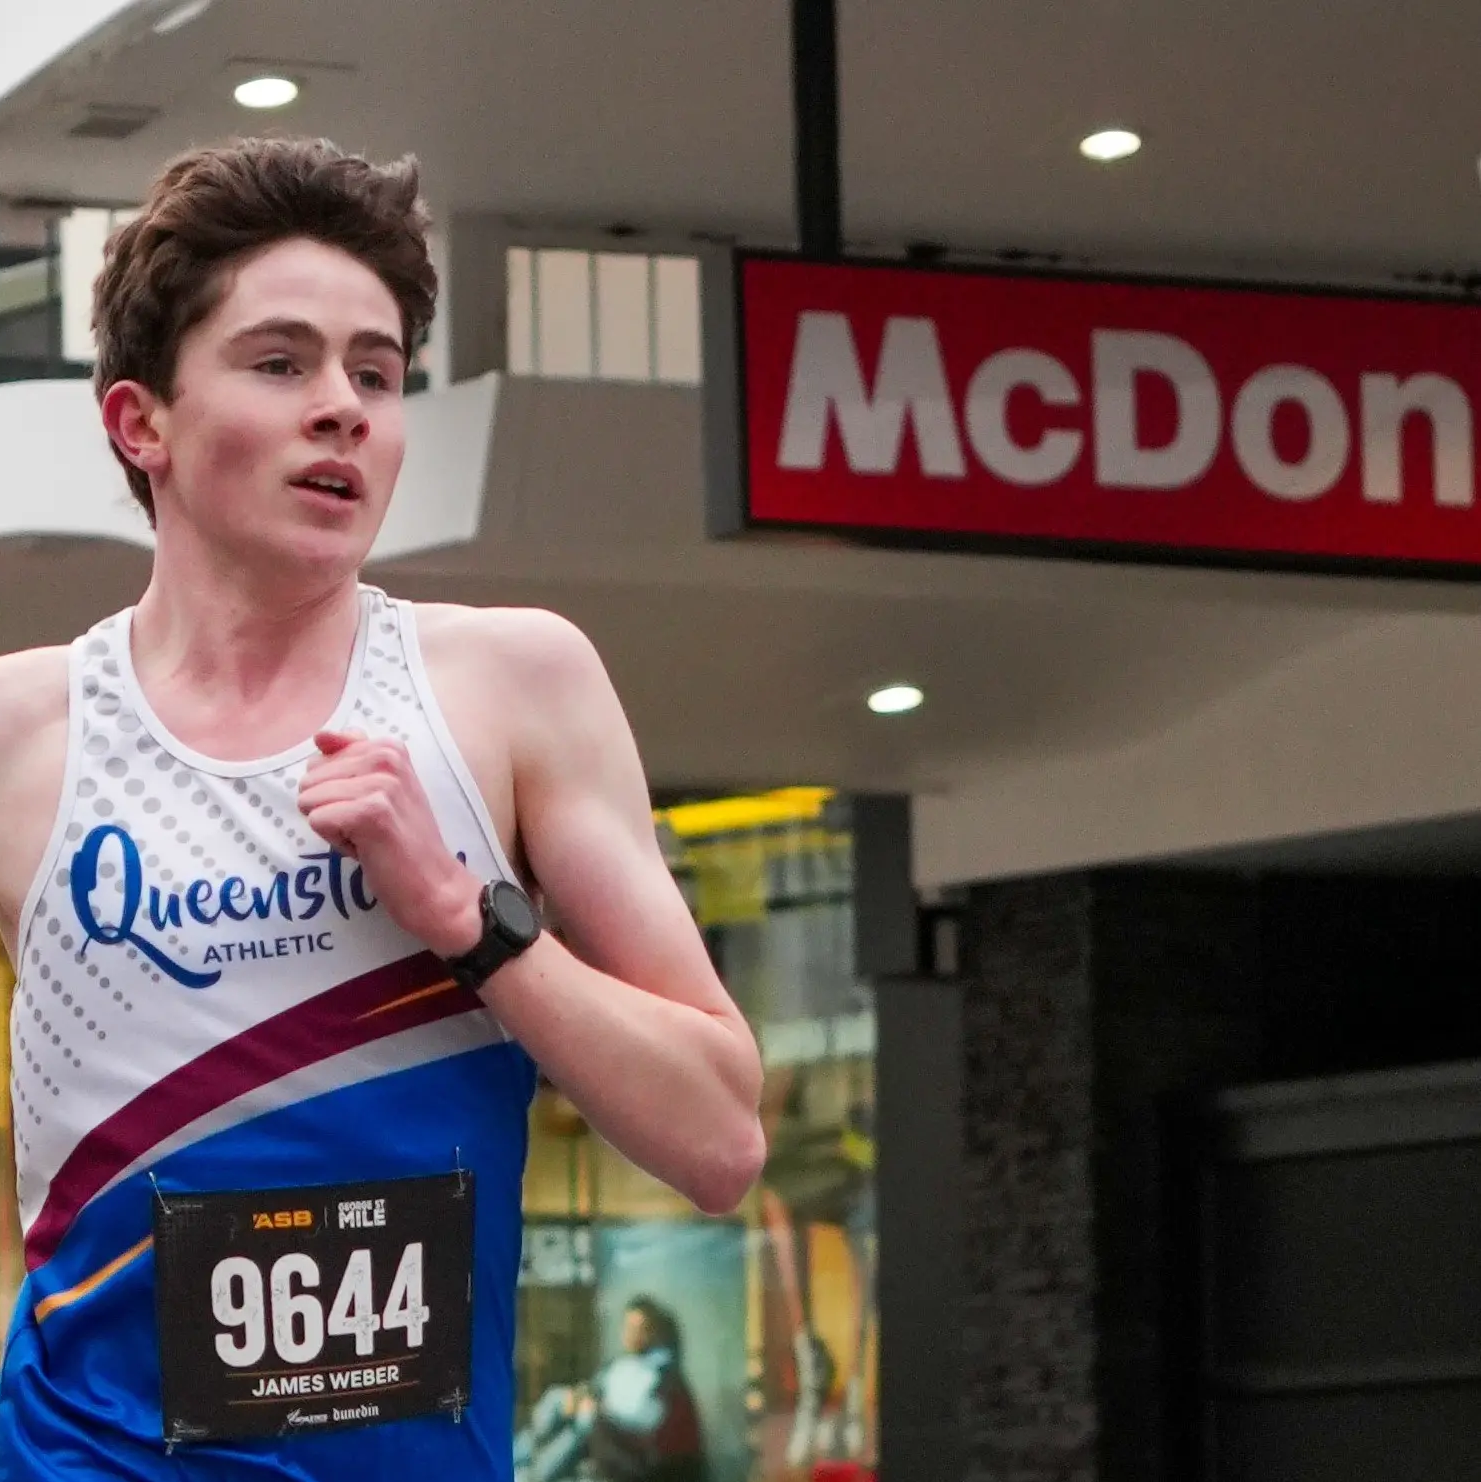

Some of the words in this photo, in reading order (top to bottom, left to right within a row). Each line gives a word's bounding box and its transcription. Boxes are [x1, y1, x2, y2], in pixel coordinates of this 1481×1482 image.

[776, 310, 1475, 508] McDon
[70, 824, 467, 988] Queensto
[203, 932, 334, 965] ATHLETIC
[253, 1210, 313, 1229] ASB
[338, 1209, 386, 1229] MILE
[210, 1242, 429, 1367] 9644
[252, 1373, 324, 1397] JAMES
[329, 1365, 399, 1389] WEBER
